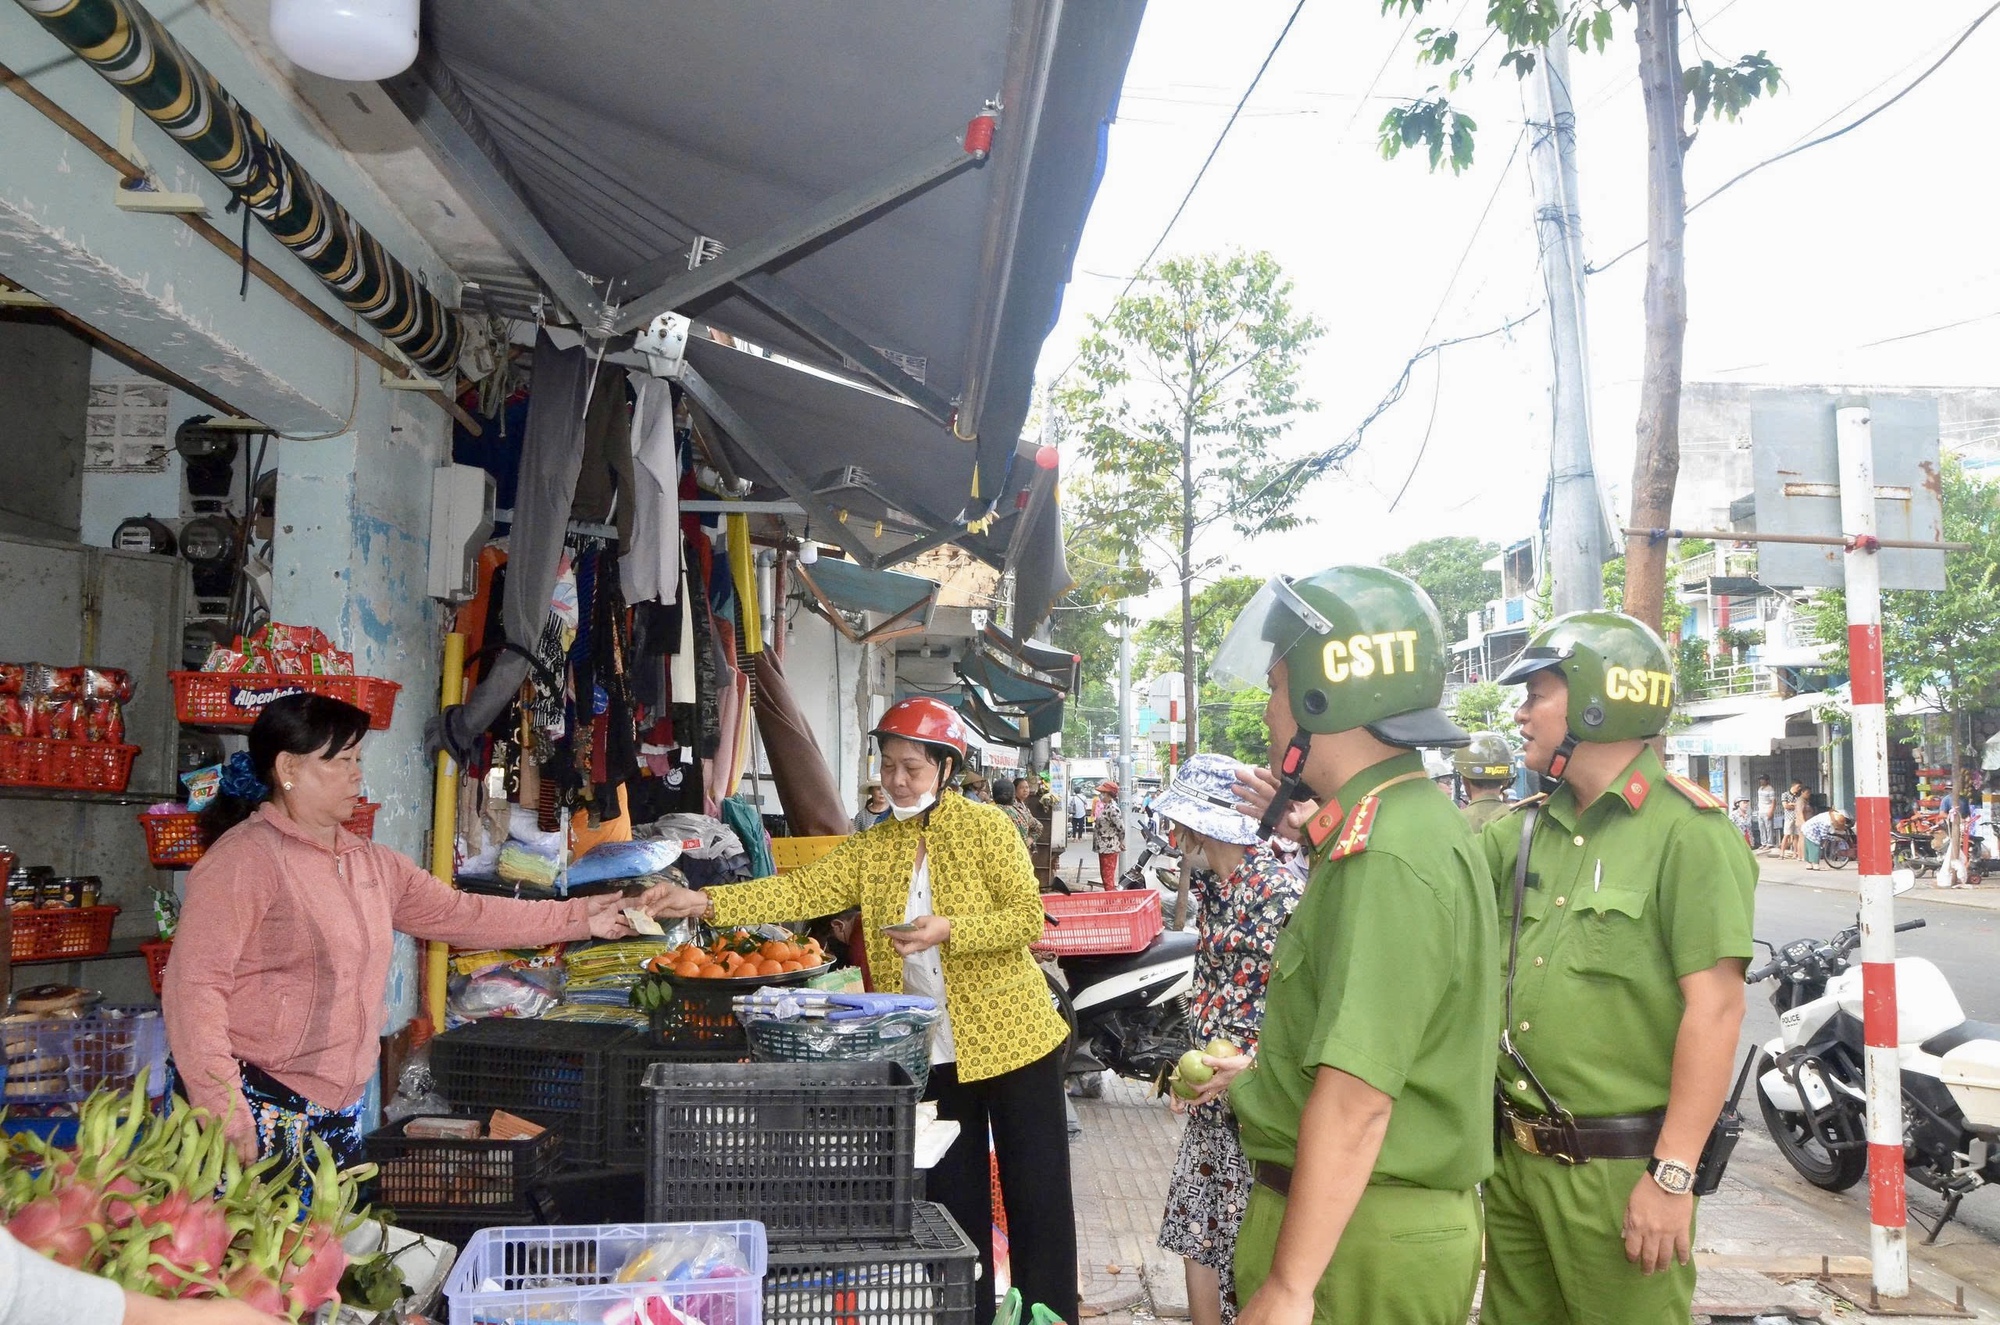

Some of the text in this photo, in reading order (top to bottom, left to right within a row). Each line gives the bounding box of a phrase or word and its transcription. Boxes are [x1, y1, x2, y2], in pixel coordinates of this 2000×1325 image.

[1322, 630, 1418, 683] CSTT
[1606, 666, 1673, 708] CSTT
[1782, 1014, 1800, 1023] POLICE
